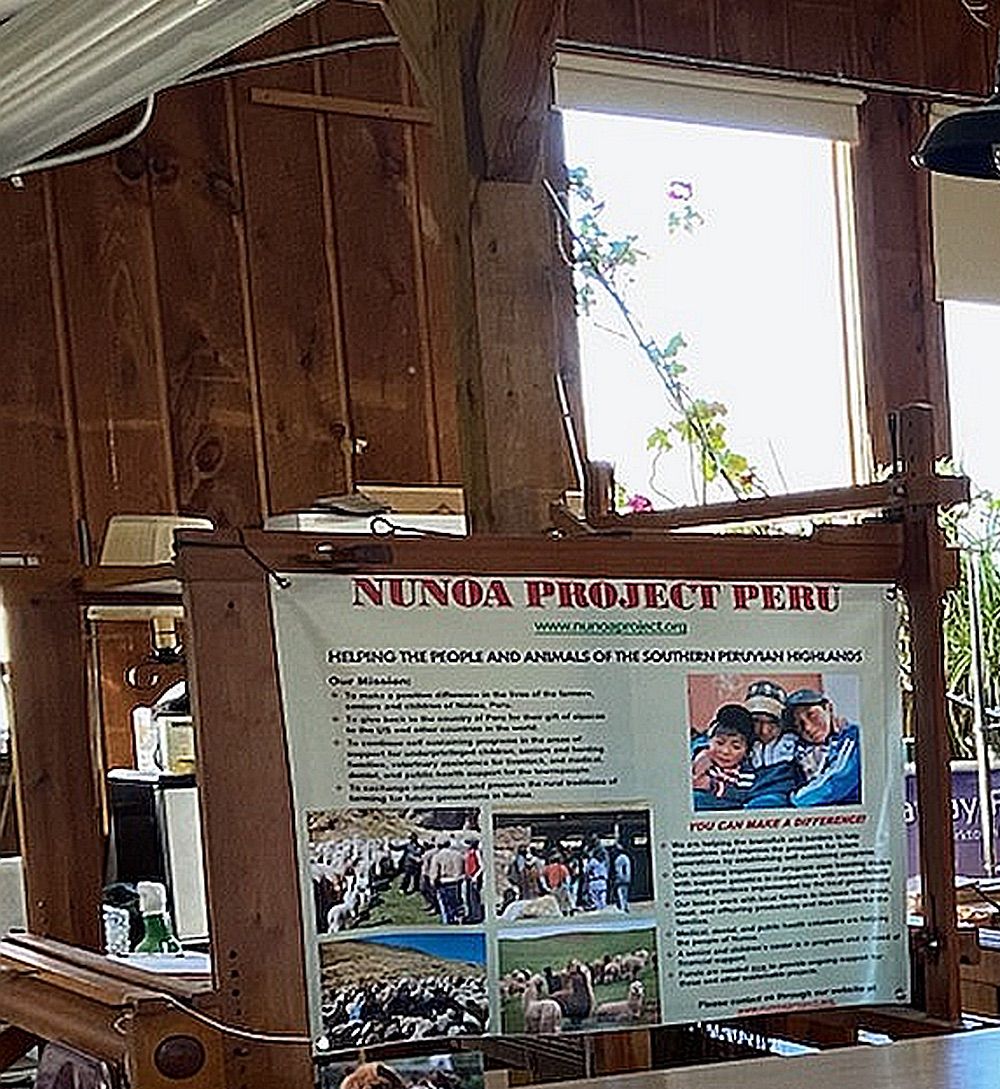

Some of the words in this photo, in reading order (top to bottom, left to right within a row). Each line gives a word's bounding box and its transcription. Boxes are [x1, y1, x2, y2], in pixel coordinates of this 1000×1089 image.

[353, 578, 512, 608] NUNOA
[524, 580, 720, 610] PROJECT
[733, 584, 840, 612] PERU
[534, 620, 687, 635] www.nunoaproject.org
[327, 650, 396, 663] HELPING
[399, 650, 427, 663] THE
[430, 650, 483, 663] PEOPLE
[486, 650, 521, 663] AND
[524, 650, 589, 663] ANIMALS
[593, 650, 611, 663] OF
[615, 650, 639, 663] THE
[642, 650, 716, 663] SOUTHERN
[718, 650, 784, 663] PERUVIAN
[787, 650, 863, 663] HIGHLANDS
[328, 675, 354, 686] Our
[690, 821, 715, 831] YOU
[718, 820, 745, 831] CAN
[783, 818, 791, 827] A
